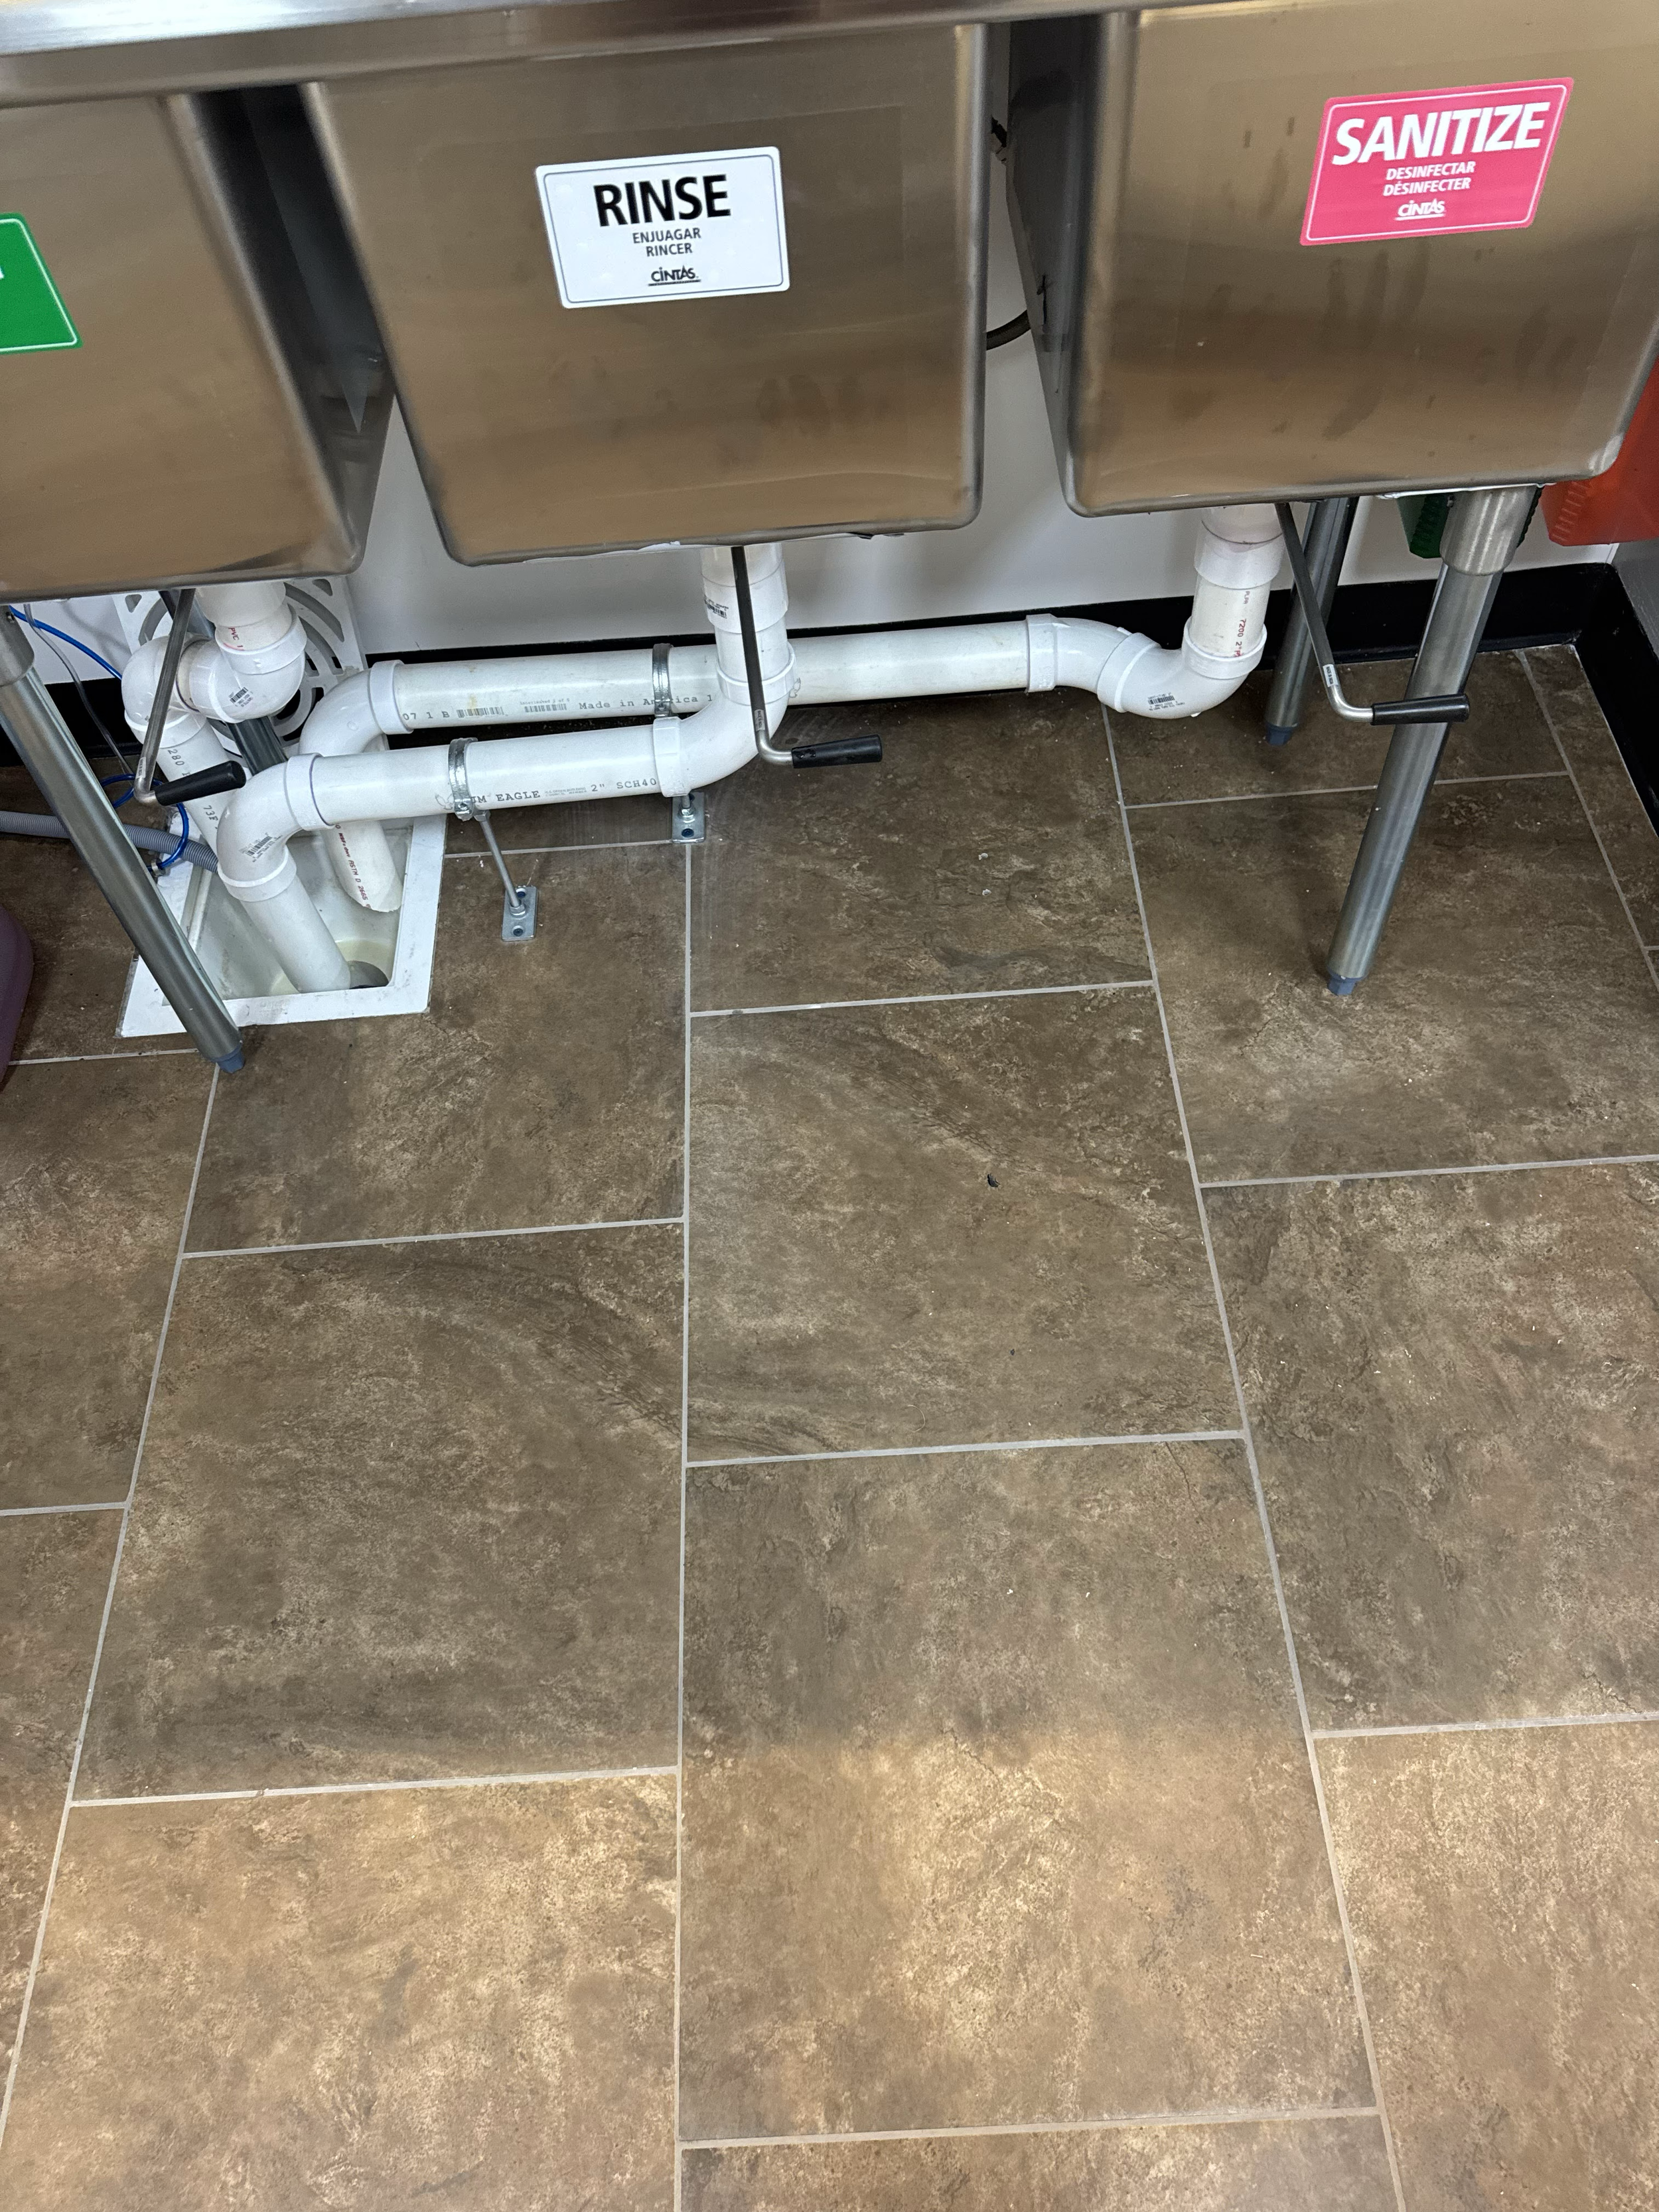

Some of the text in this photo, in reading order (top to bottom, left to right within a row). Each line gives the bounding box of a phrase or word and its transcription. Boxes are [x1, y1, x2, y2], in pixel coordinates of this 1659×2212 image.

[1332, 102, 1551, 165] SANITIZE
[1386, 161, 1476, 181] DESINFECTAR
[1383, 177, 1471, 196] DÉSINFECTER
[593, 174, 731, 227] RINSE
[632, 228, 701, 244] ENJUAGAR
[646, 242, 693, 257] RINCER
[1237, 618, 1246, 637] 7200
[167, 749, 184, 766] 280
[616, 778, 657, 790] SCH40
[496, 790, 540, 802] EAGLE
[348, 859, 358, 875] ASTM
